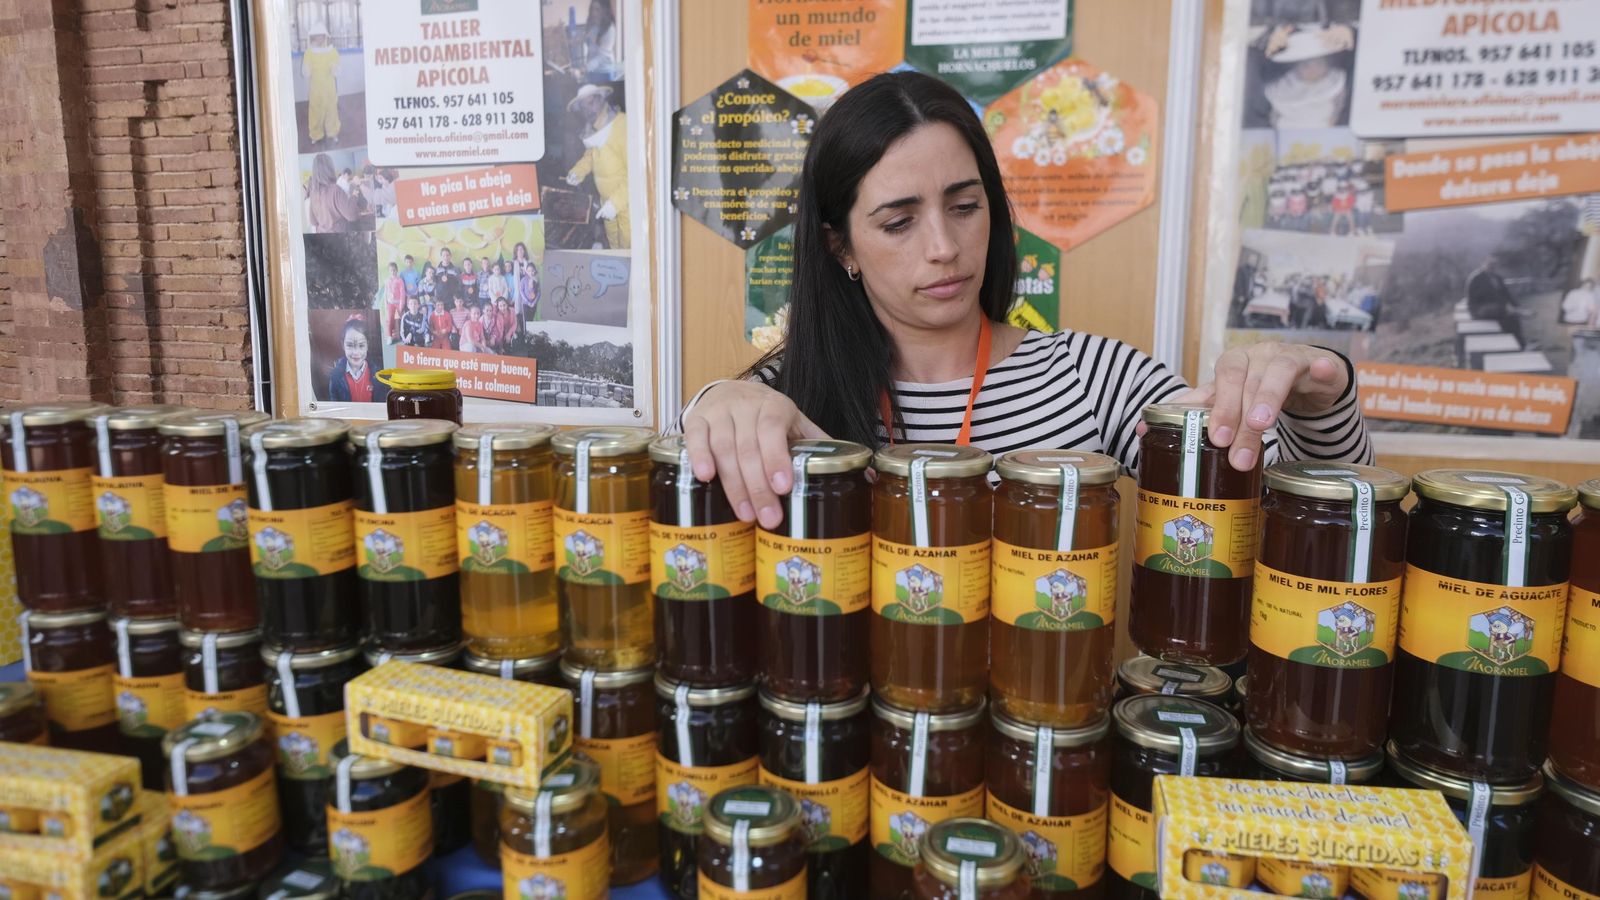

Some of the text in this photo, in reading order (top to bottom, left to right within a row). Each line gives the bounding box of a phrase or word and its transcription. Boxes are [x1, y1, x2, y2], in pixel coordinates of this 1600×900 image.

[776, 7, 876, 25] un mundo
[1443, 9, 1560, 37] APÍCOLA
[420, 19, 480, 40] TALLER
[789, 30, 861, 46] de miel
[374, 40, 534, 65] MEDIOAMBIENTAL
[954, 46, 1021, 59] LA MIEL DE
[1480, 46, 1511, 62] 957
[1519, 44, 1552, 60] 641
[1563, 42, 1595, 58] 105
[417, 66, 489, 88] APÍCOLA
[1373, 75, 1404, 91] 957
[1411, 74, 1442, 89] 641
[1453, 72, 1484, 88] 178
[1504, 70, 1538, 86] 628
[1546, 68, 1579, 84] 911
[394, 92, 514, 109] TLFNOS. 957 641 105
[717, 93, 775, 108] ¿Conoce
[378, 118, 400, 129] 957
[403, 116, 425, 129] 641
[429, 115, 450, 128] 178
[461, 114, 483, 126] 628
[486, 113, 506, 125] 911
[511, 112, 534, 124] 308
[702, 110, 790, 127] el propóleo?
[415, 147, 499, 159] www.moramiel.com
[683, 139, 790, 150] Un producto medicinal
[1531, 143, 1550, 163] la
[684, 152, 805, 161] podemos disfrutar graci
[733, 164, 775, 174] queridas
[421, 174, 512, 197] No pica la abeja
[1515, 172, 1558, 193] deja
[692, 187, 799, 198] Descubra el propóleo y
[407, 193, 531, 220] a quien en paz la deja
[704, 200, 755, 208] enamórese
[720, 212, 770, 220] beneficios.
[1013, 277, 1054, 294] otas
[403, 352, 532, 379] De tierra que esté muy buena,
[456, 378, 520, 395] rtes la colmena
[1187, 420, 1196, 454] Precinto
[915, 473, 923, 502] Precinto
[1065, 478, 1076, 511] Precinto
[1149, 496, 1226, 511] DE MIL FLORES
[1360, 497, 1368, 531] Precinto
[1513, 507, 1524, 544] Precinto
[675, 532, 717, 540] TOMILLO
[759, 538, 832, 553] MIEL DE TOMILLO
[879, 542, 957, 558] MIEL DE AZAHAR
[1011, 548, 1099, 561] MIEL DE AZAHAR
[1269, 573, 1388, 596] MIEL DE MIL FLORES
[1438, 581, 1562, 600] MIEL DE AGUACATE
[1279, 609, 1303, 618] NATURAL
[677, 771, 717, 780] TOMILLO
[794, 788, 838, 796] TOMILLO
[891, 794, 902, 802] DE
[905, 798, 947, 807] AZAHAR
[992, 801, 1072, 827] MIEL DE AZAHAR
[1115, 801, 1148, 824] MIEL DE
[1217, 802, 1413, 829] un mundo de miel
[1472, 794, 1485, 827] Precinto
[1222, 831, 1419, 866] MIELES SURTIDAS
[1537, 871, 1579, 900] MIEL DE
